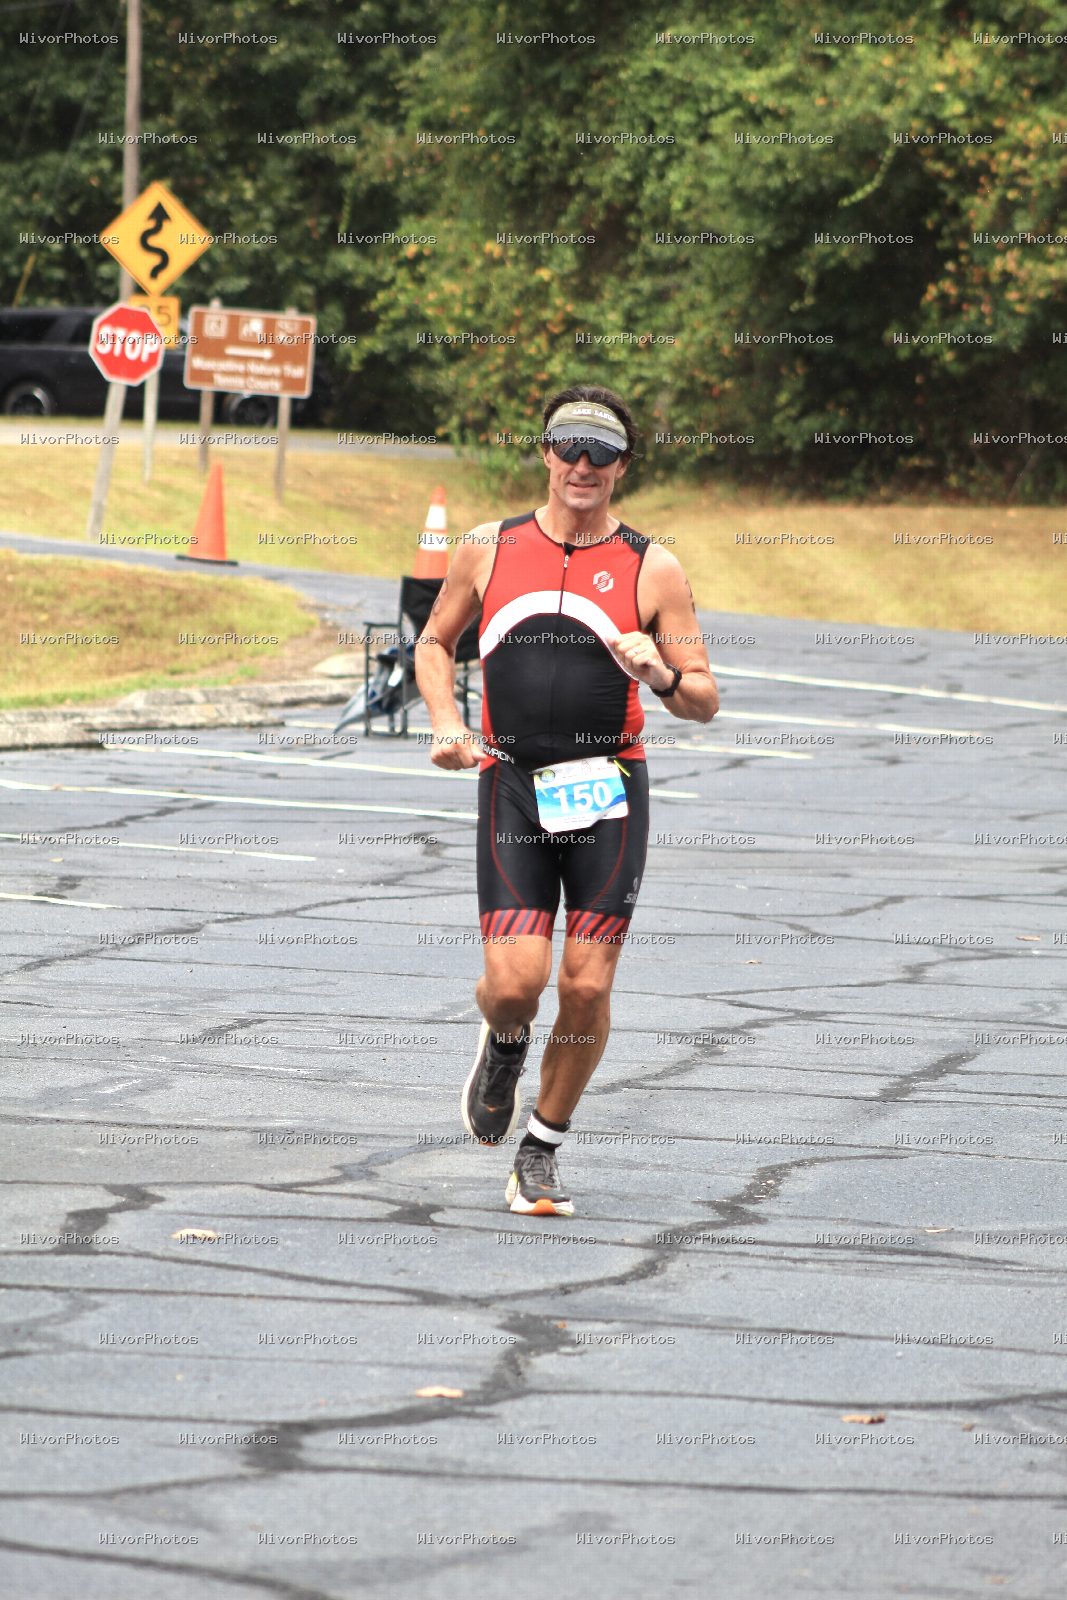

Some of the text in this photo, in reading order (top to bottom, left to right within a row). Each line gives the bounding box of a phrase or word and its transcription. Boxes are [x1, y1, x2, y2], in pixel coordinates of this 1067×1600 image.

[139, 304, 172, 327] 5
[96, 325, 160, 363] STOP
[553, 781, 612, 814] 150
